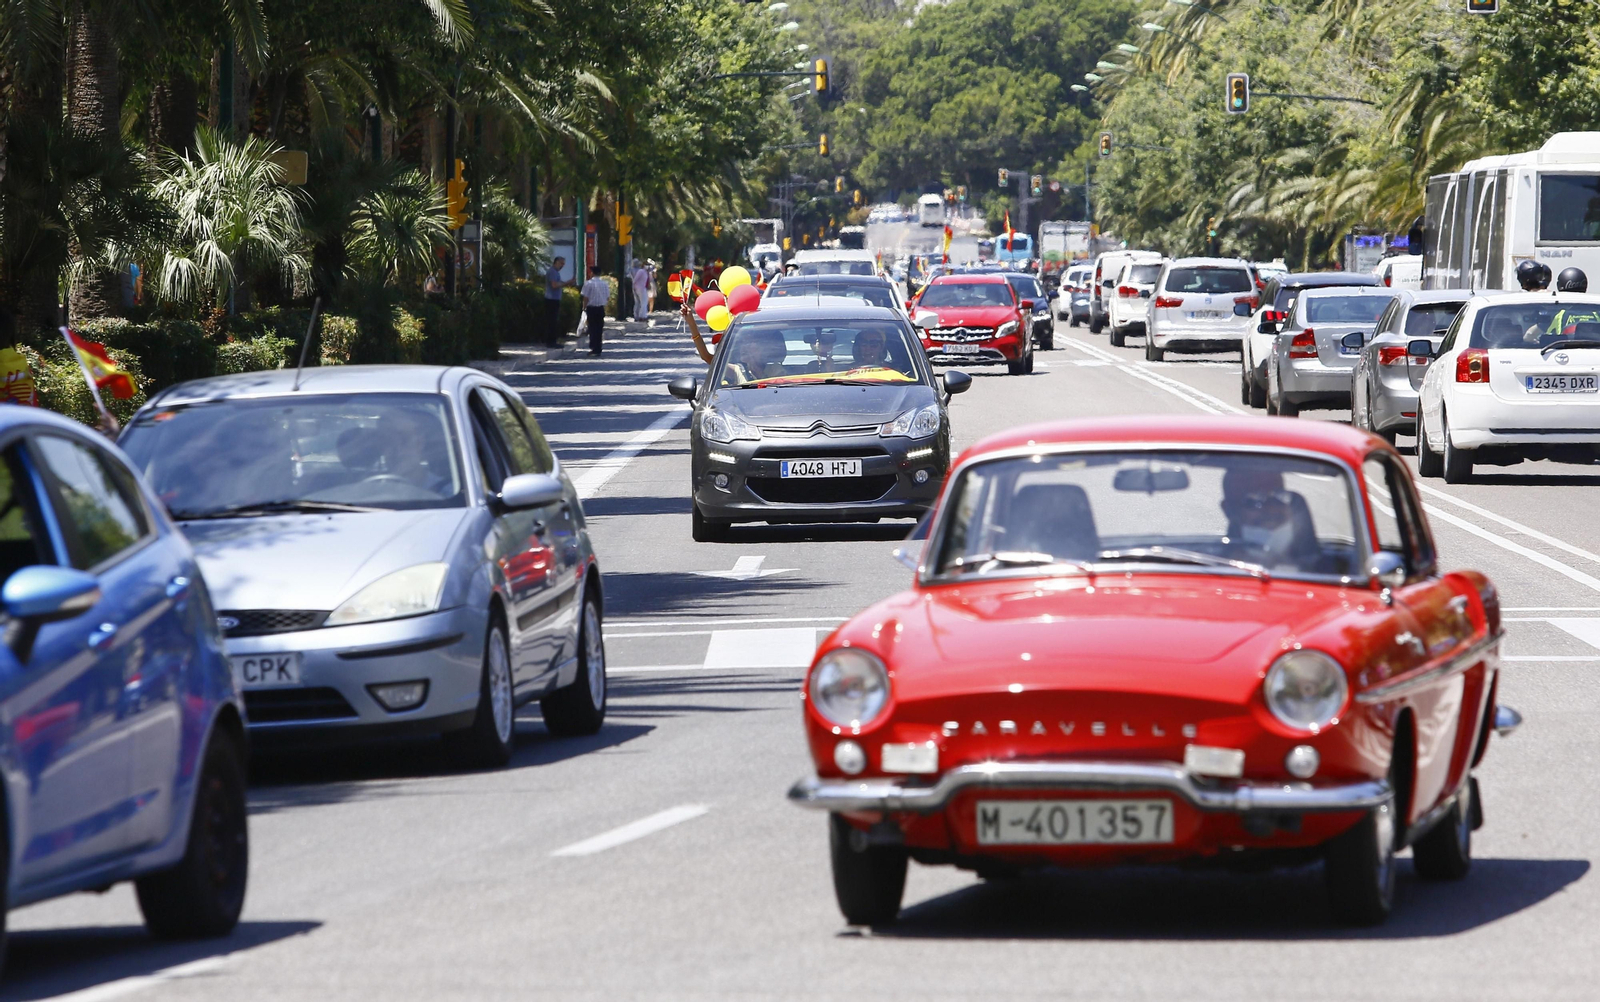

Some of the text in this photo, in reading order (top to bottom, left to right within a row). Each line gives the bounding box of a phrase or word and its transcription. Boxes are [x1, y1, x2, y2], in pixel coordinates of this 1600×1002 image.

[1540, 250, 1573, 258] MAN
[1535, 377, 1594, 389] 2345 DXR
[791, 462, 824, 476] 4048
[831, 461, 856, 475] HTJ
[242, 657, 292, 683] CPK
[942, 720, 1197, 738] CARAVELLE
[980, 804, 1167, 841] M-401357
